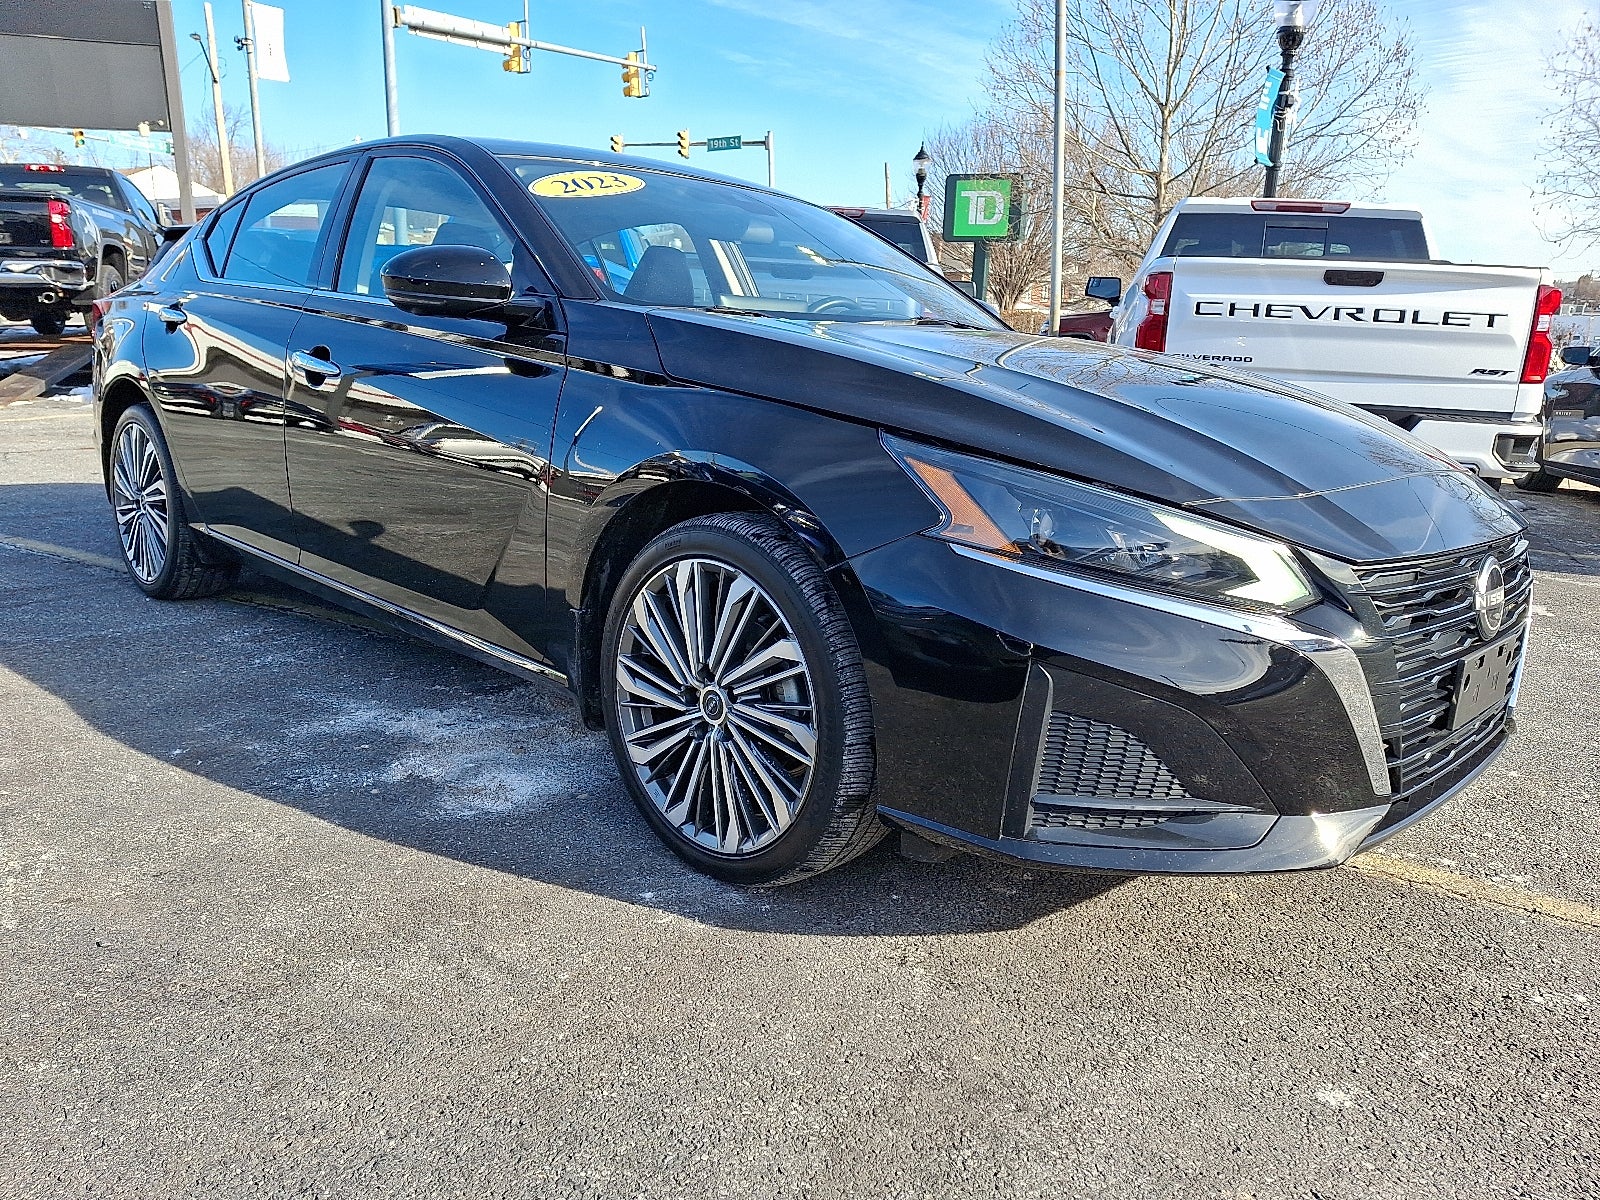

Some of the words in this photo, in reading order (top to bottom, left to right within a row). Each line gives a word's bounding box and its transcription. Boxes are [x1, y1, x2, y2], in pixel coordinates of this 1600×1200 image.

[710, 140, 727, 148] 19th
[730, 138, 739, 147] St
[551, 175, 627, 193] 2023
[961, 190, 1004, 225] TD
[1194, 301, 1508, 328] CHEVROLET
